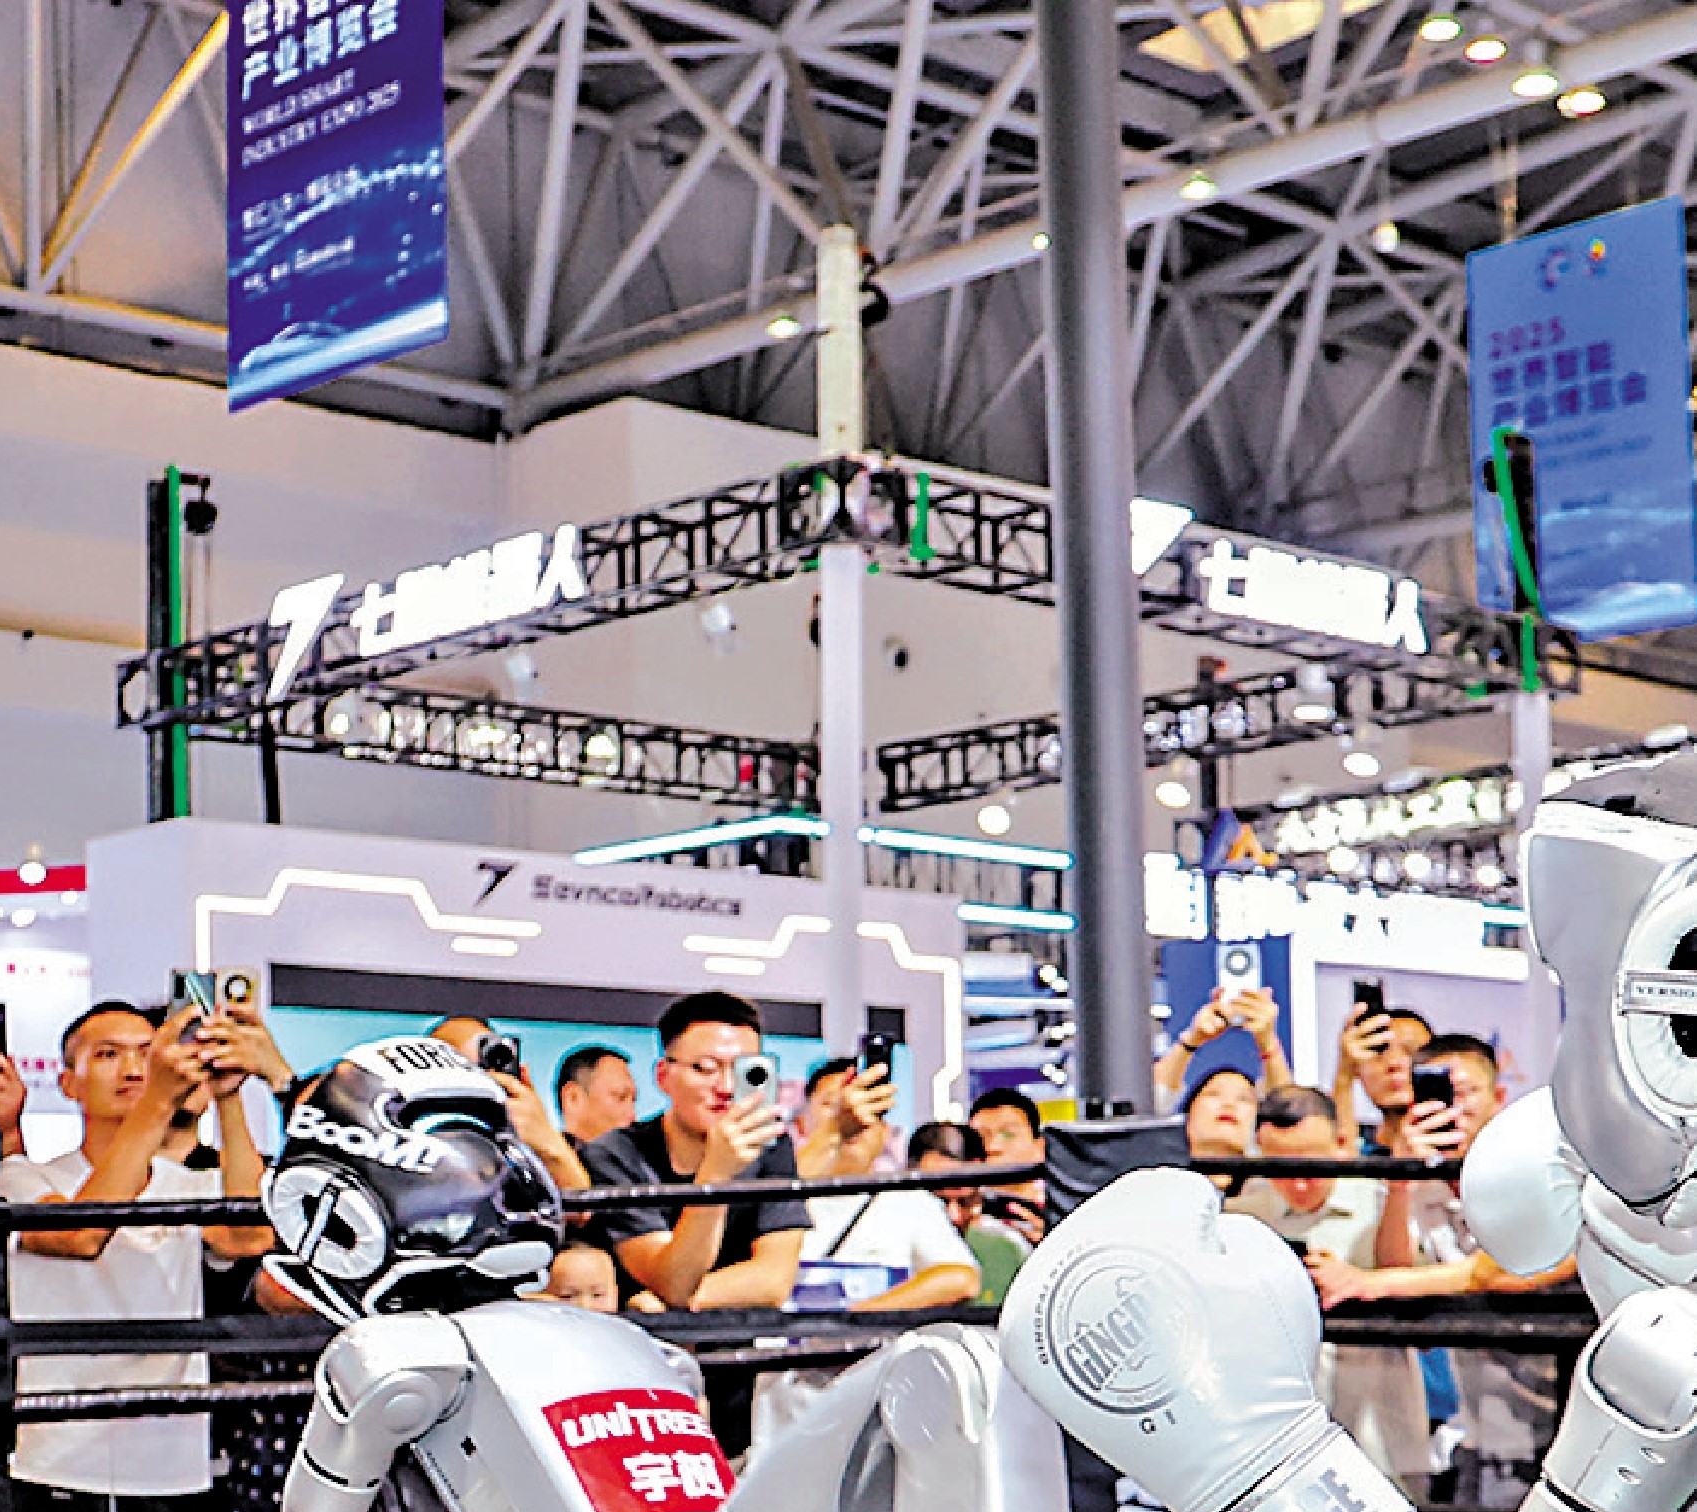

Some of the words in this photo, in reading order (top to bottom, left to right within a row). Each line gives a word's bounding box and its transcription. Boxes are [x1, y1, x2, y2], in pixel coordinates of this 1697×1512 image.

[241, 0, 399, 101] 产业博览会
[1489, 315, 1565, 361] 2025
[622, 1450, 726, 1502] 宇树
